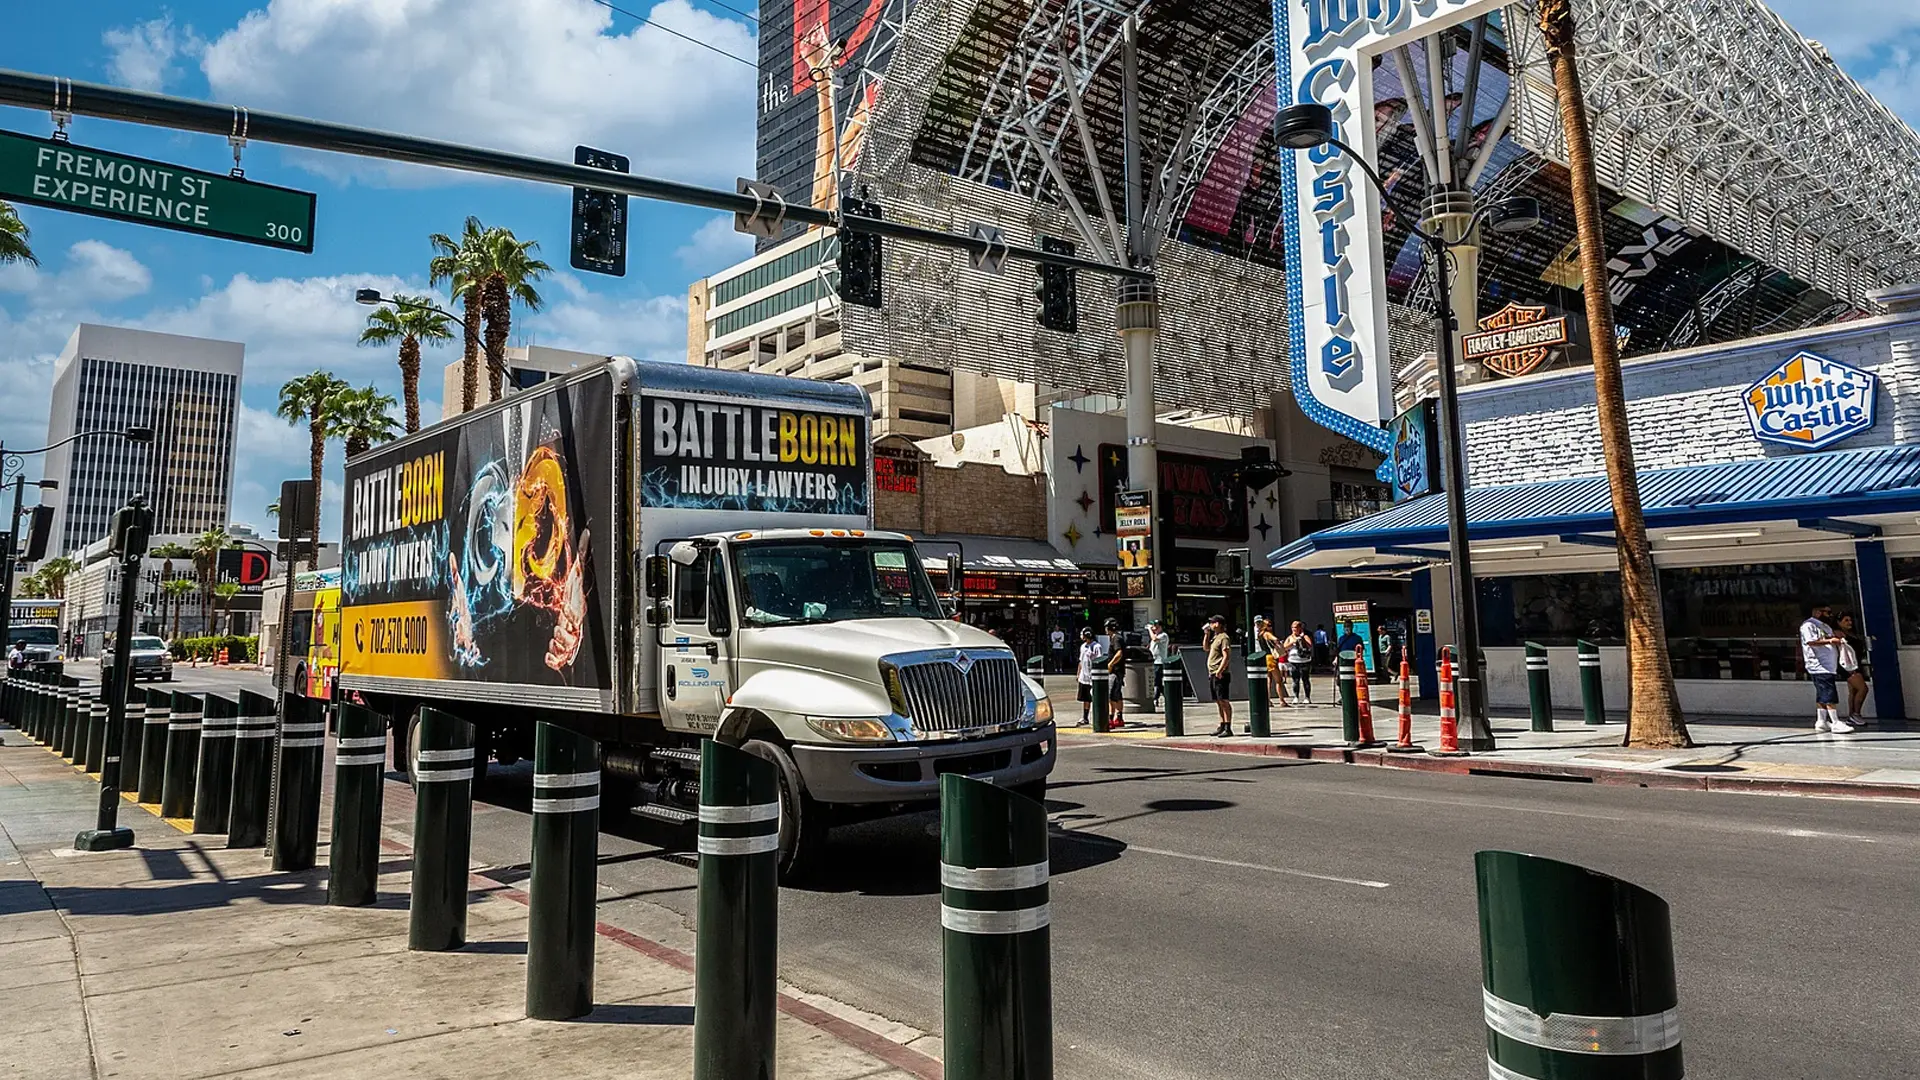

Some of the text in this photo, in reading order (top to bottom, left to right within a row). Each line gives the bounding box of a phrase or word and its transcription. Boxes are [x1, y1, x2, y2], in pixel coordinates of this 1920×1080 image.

[762, 72, 789, 114] the
[36, 147, 212, 199] FREMONT ST
[33, 174, 210, 226] EXPERIENCE
[265, 222, 303, 242] 300
[1487, 308, 1536, 330] MOTOR
[1466, 321, 1561, 355] HARLEY-DAVIDSON
[1490, 347, 1540, 374] CYCLES
[1762, 376, 1855, 410] White
[653, 399, 857, 467] BATTLEBORN
[1759, 401, 1863, 434] Castle
[680, 464, 837, 501] INJURY LAWYERS
[877, 475, 917, 494] VILLAGE
[1160, 461, 1214, 496] IVA
[351, 450, 445, 542] BATTLEBORN
[1173, 494, 1228, 528] GAS
[1119, 518, 1147, 527] JELLY ROLL
[220, 552, 269, 584] the D
[358, 538, 434, 586] INJURY LAWYERS
[10, 607, 58, 618] ATTLEBORN
[370, 615, 428, 655] 702.570.9000
